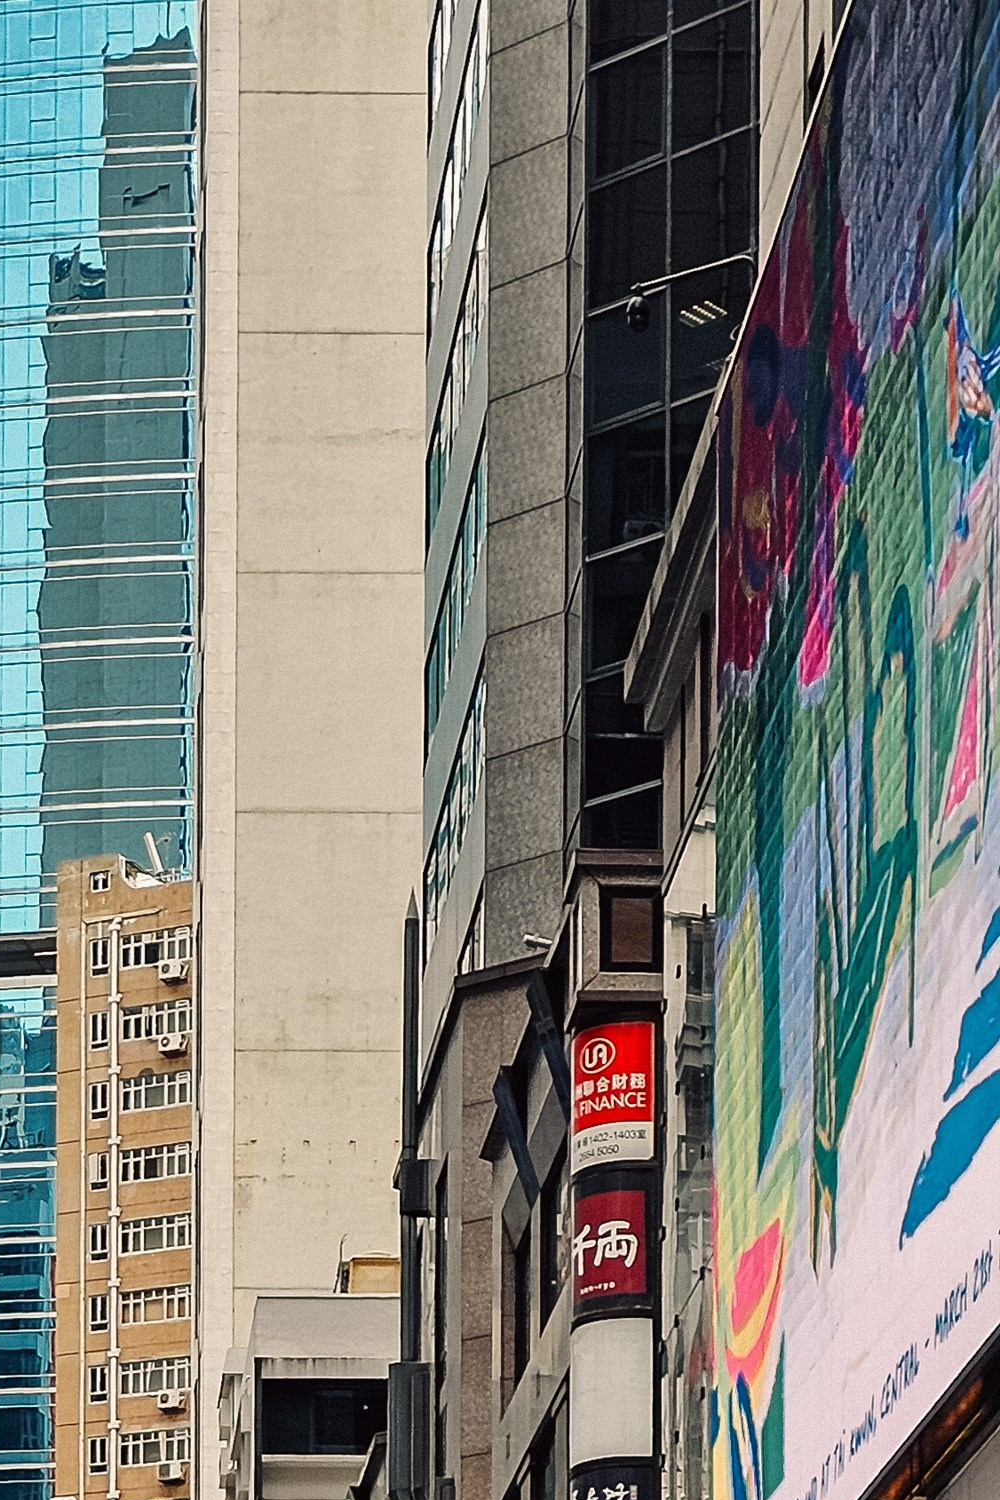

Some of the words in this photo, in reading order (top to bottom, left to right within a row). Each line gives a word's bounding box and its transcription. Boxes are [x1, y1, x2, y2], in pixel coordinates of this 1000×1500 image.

[580, 1091, 646, 1117] FINANCE
[820, 1454, 831, 1500] AT
[880, 1341, 920, 1419] CENTRAL
[934, 1272, 968, 1351] MARCH
